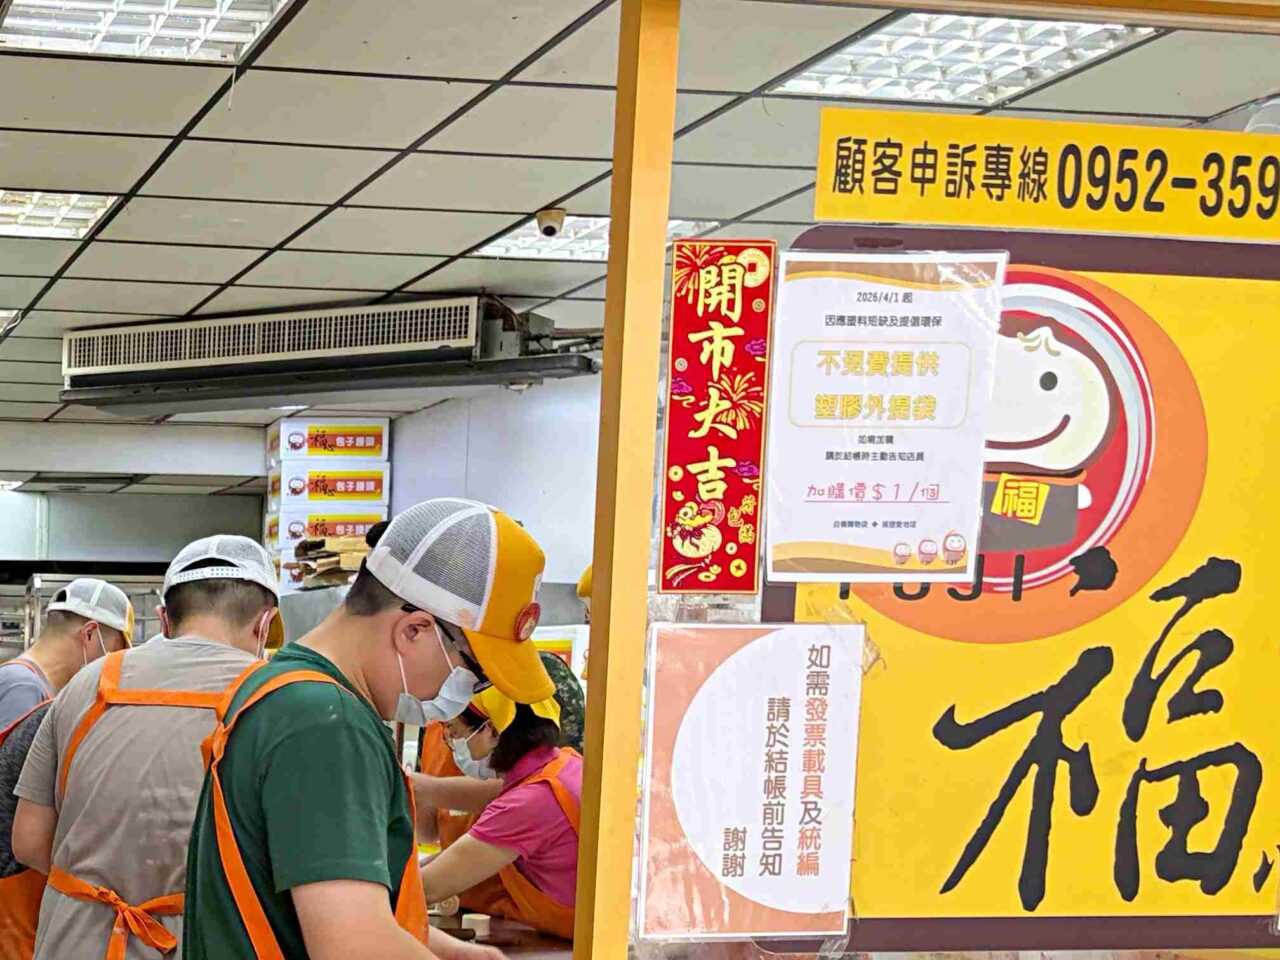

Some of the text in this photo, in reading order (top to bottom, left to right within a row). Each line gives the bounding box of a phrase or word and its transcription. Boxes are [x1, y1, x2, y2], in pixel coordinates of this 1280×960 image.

[833, 136, 1280, 220] 顧客申訴專線 0952-359
[686, 263, 747, 503] 開市大吉
[816, 350, 941, 377] 不免費提供
[759, 697, 791, 877] 請於結帳前告知
[796, 644, 831, 877] 如需發票載具及統編
[932, 546, 1280, 912] 福
[722, 827, 747, 878] 謝謝
